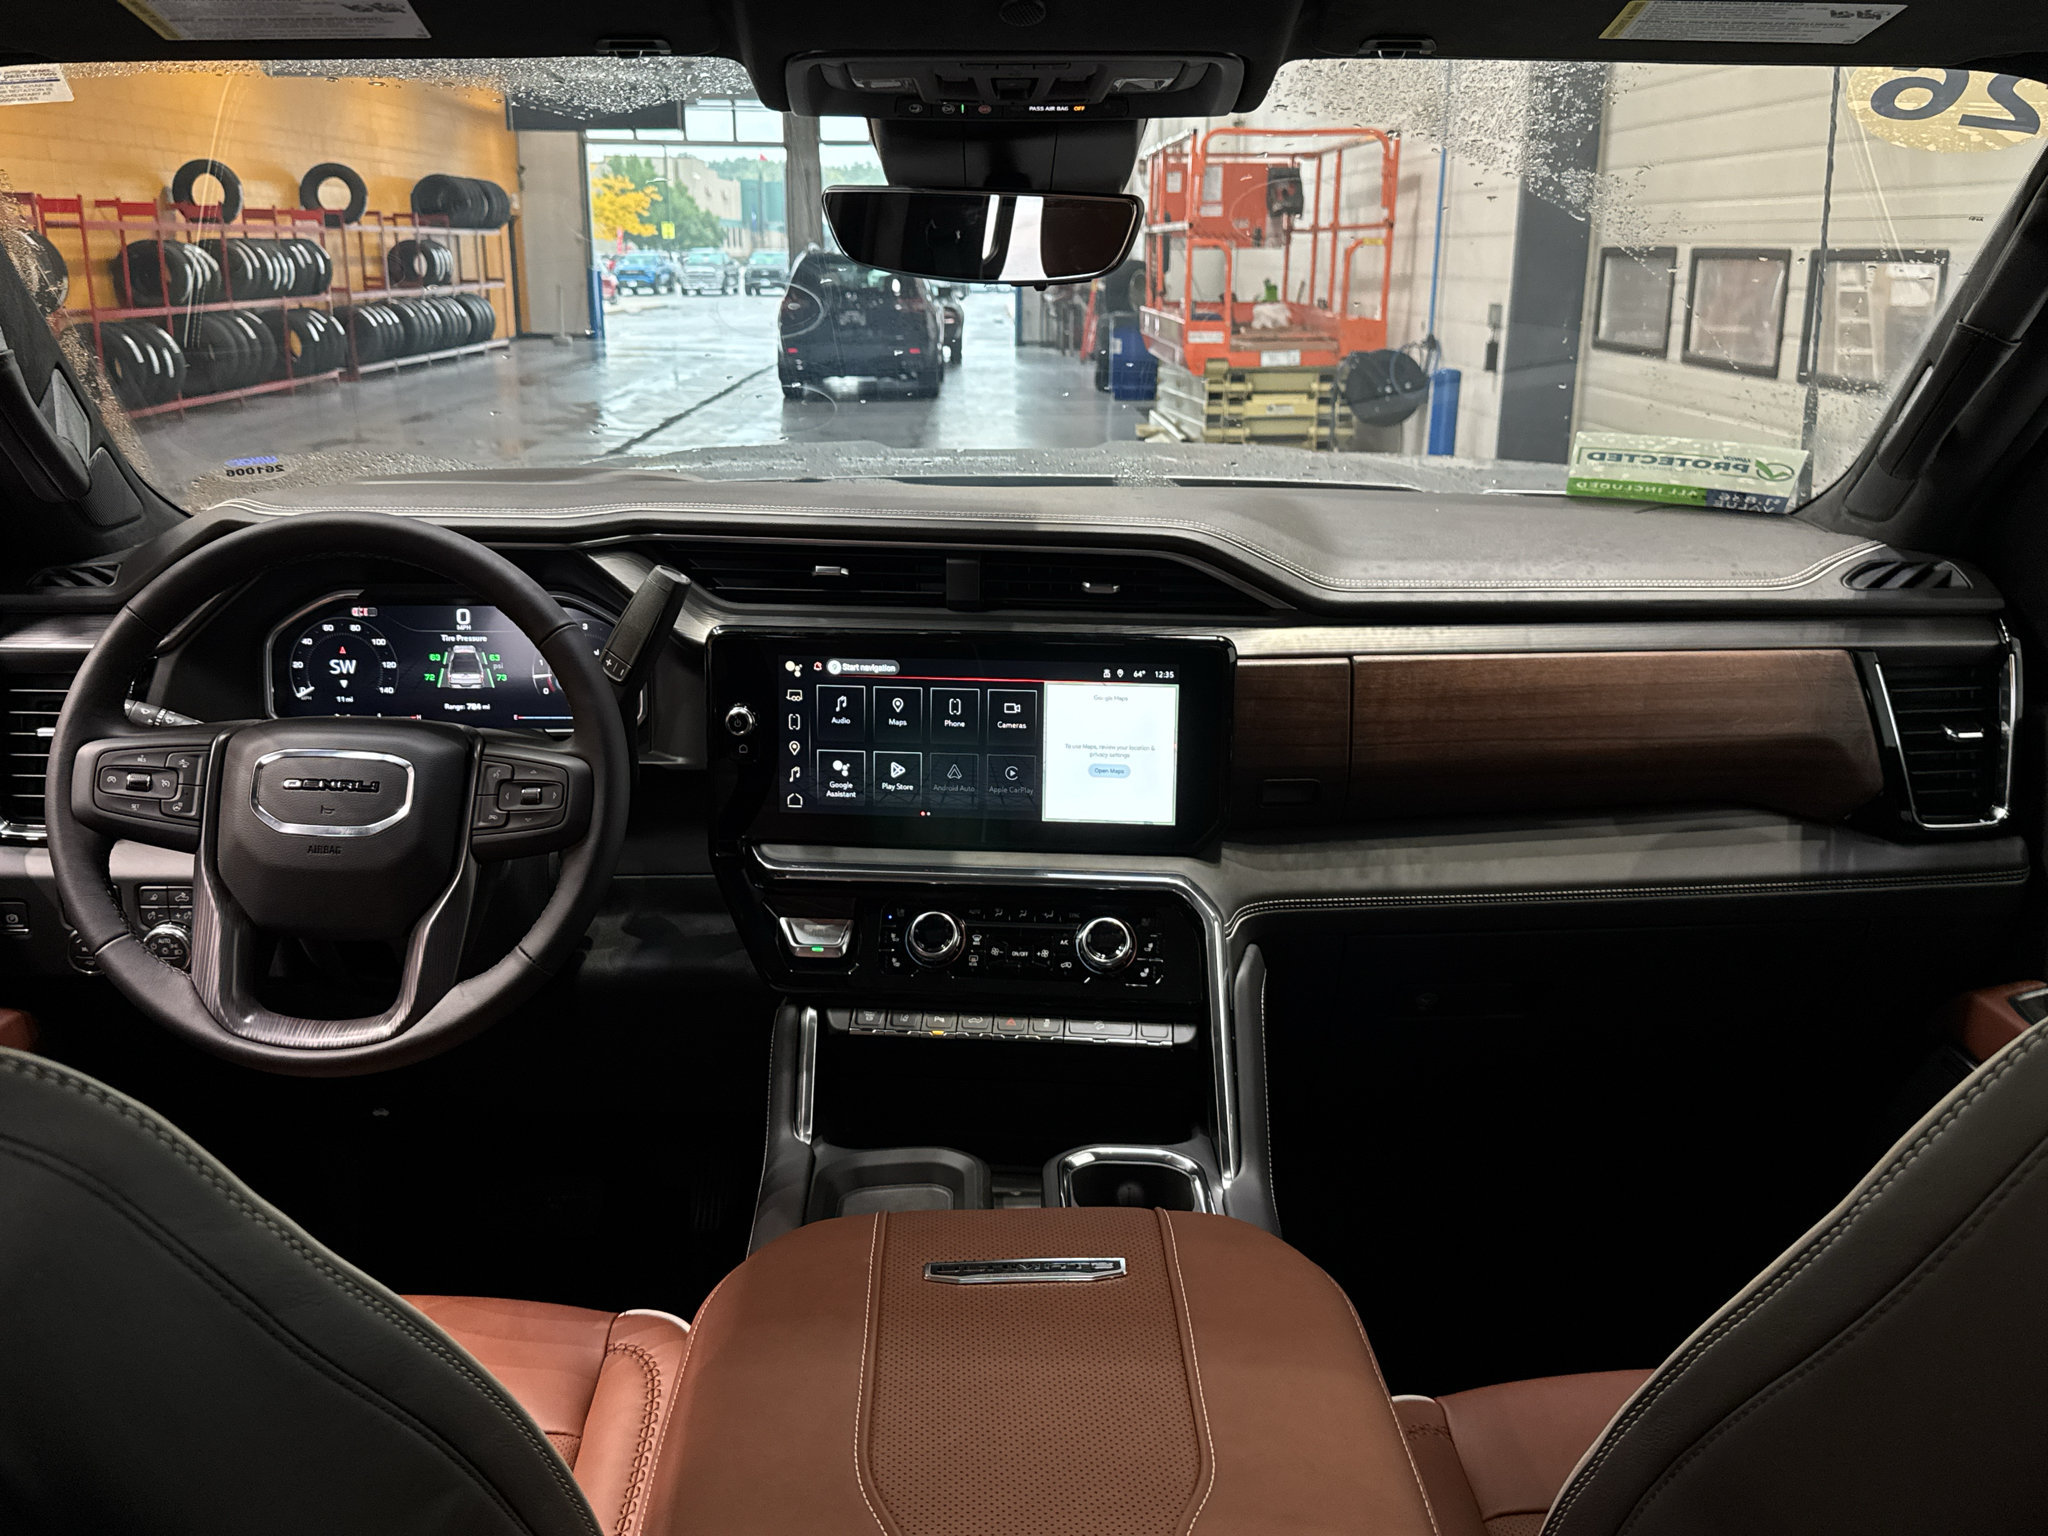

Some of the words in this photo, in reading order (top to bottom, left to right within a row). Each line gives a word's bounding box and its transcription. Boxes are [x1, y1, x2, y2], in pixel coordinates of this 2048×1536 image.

[456, 608, 470, 624] 0
[371, 638, 386, 646] 100
[440, 634, 455, 642] Tire
[456, 634, 487, 642] Pressure
[329, 659, 356, 674] SW
[842, 663, 859, 671] Start
[860, 663, 896, 673] navigation
[424, 673, 435, 681] 72
[1155, 670, 1174, 678] 12:35
[443, 703, 465, 711] Range:
[831, 717, 851, 725] Audio
[888, 718, 907, 727] Maps
[944, 719, 965, 727] Phone
[997, 721, 1027, 729] Cameras
[829, 780, 853, 790] Google
[882, 782, 895, 791] Play
[896, 783, 913, 791] Store
[933, 784, 958, 792] Android
[826, 790, 856, 798] Assistant
[989, 785, 1007, 794] Apple
[1008, 786, 1034, 795] CarPlay
[307, 845, 342, 854] AIRBAG
